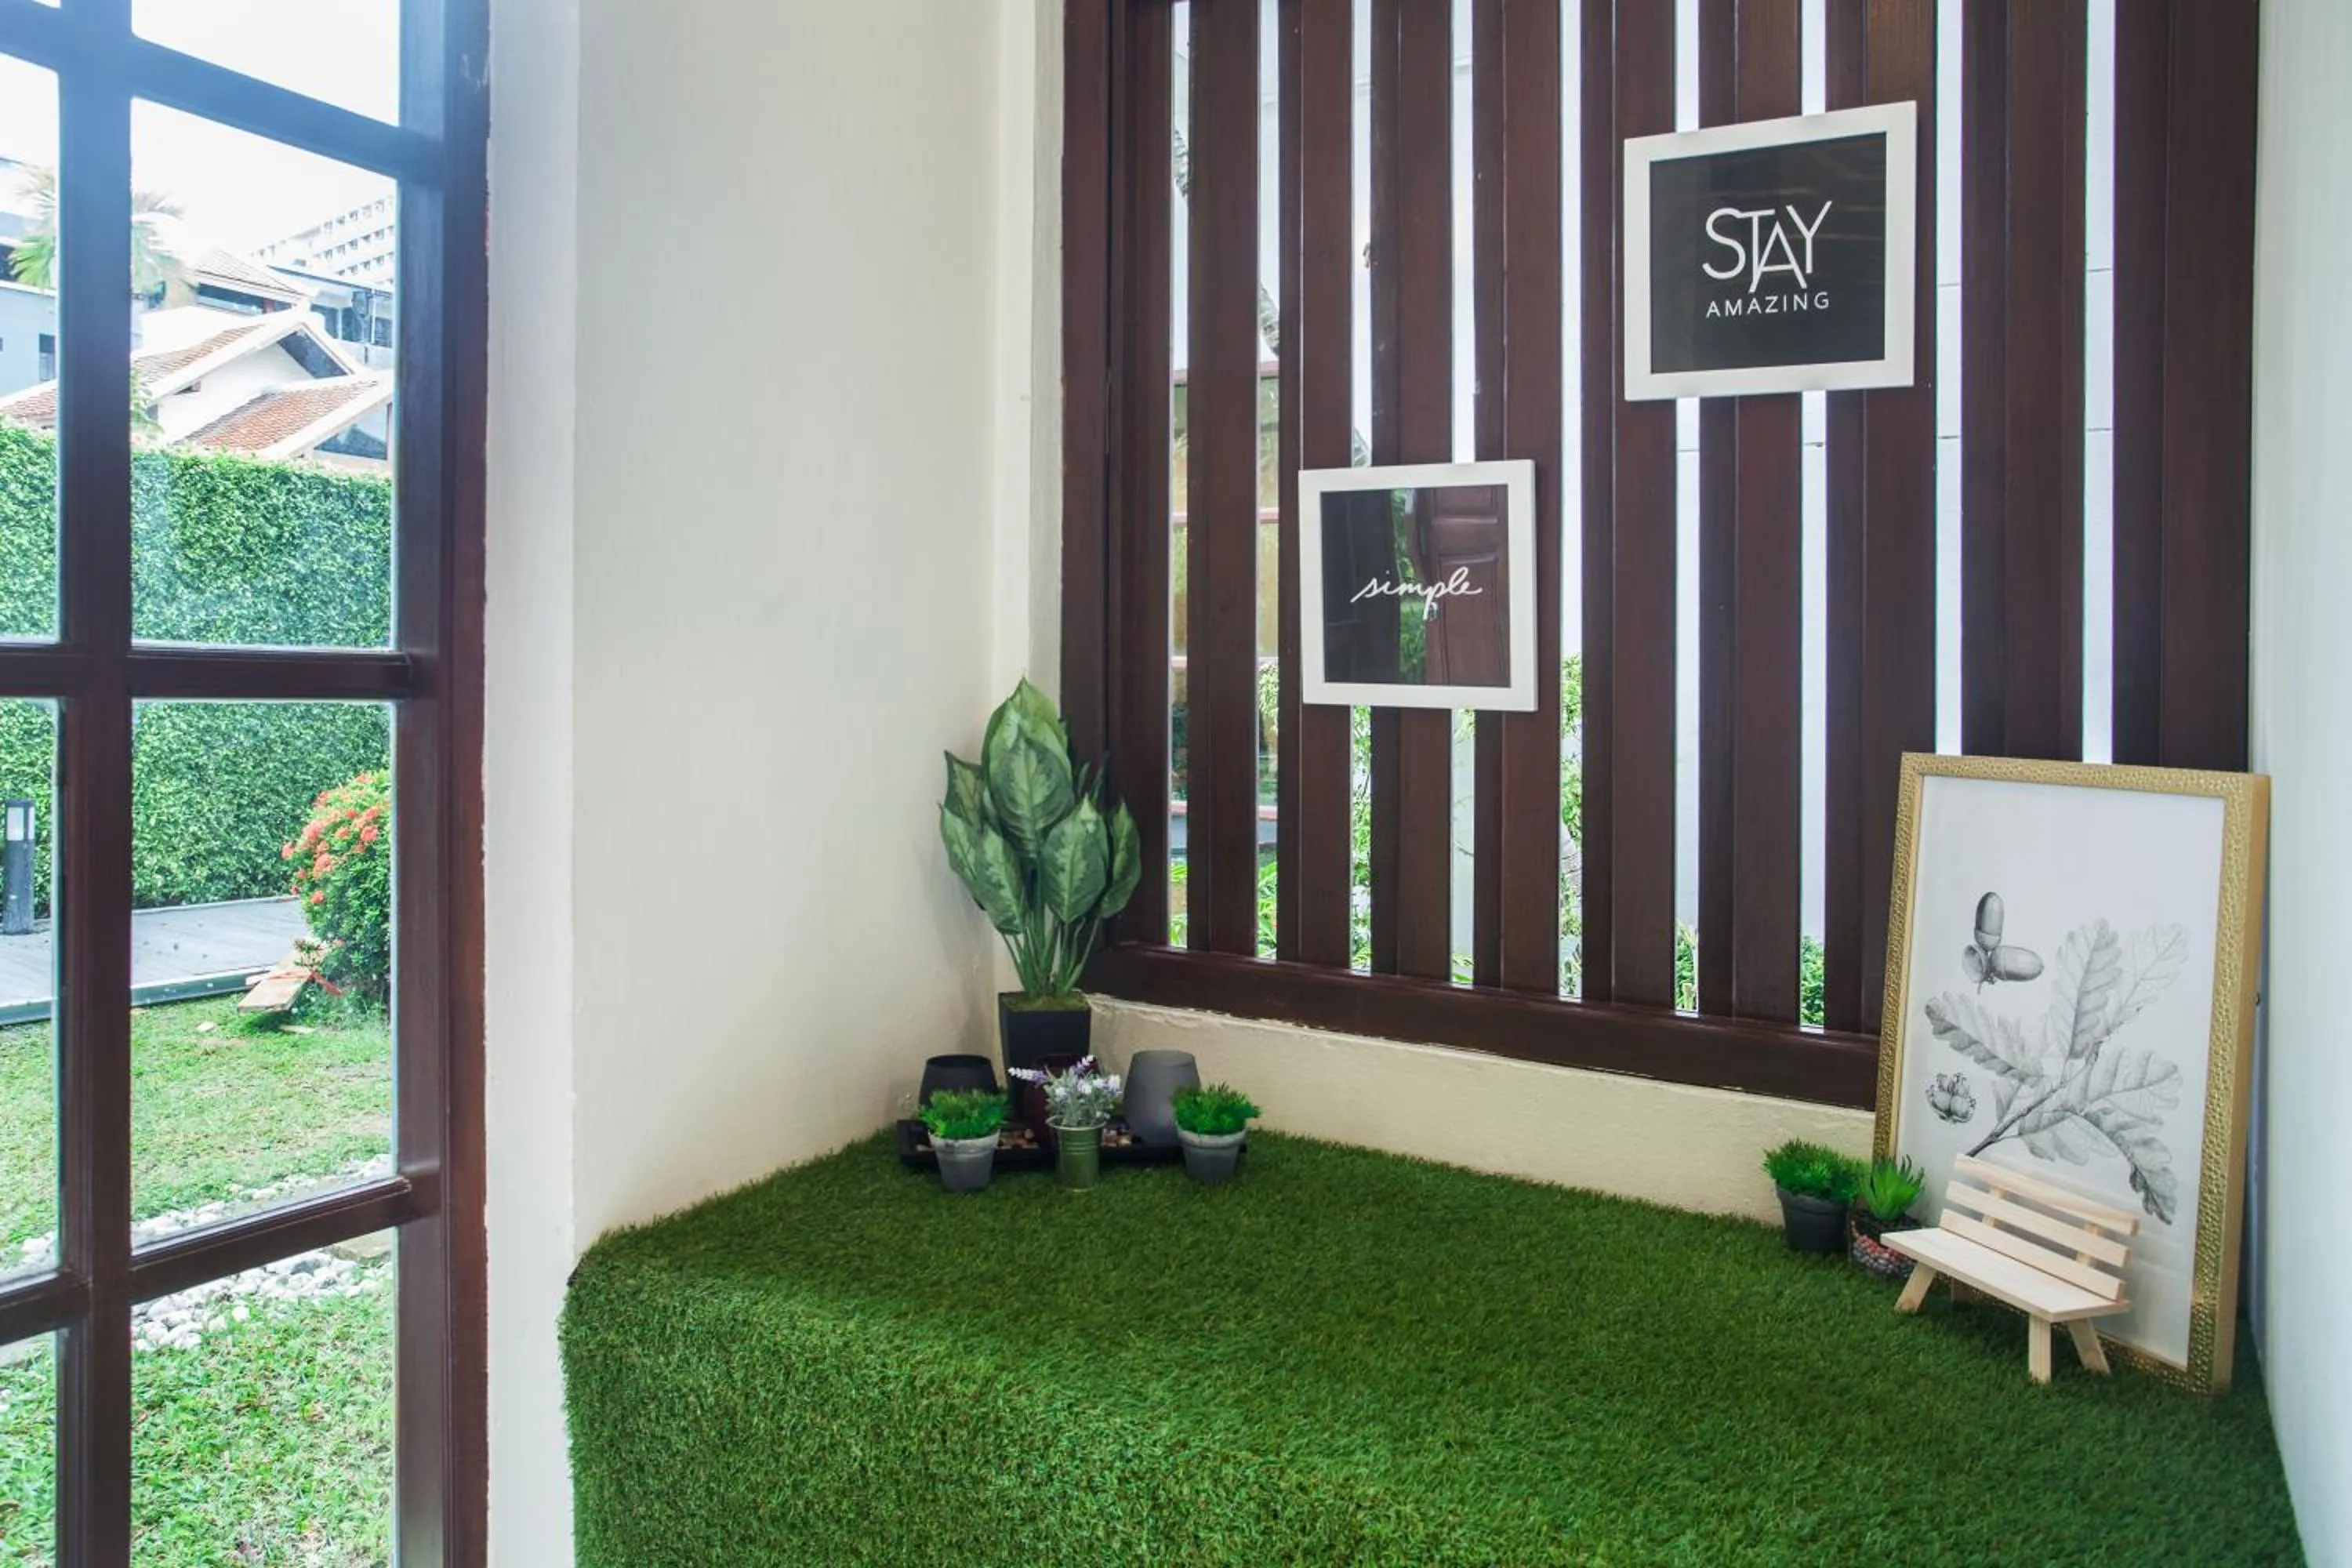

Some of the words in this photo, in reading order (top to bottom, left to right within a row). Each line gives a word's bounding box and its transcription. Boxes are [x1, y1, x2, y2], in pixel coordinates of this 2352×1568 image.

[1702, 200, 1833, 294] STAY
[1705, 291, 1830, 318] AMAZING
[1349, 566, 1483, 620] simple
